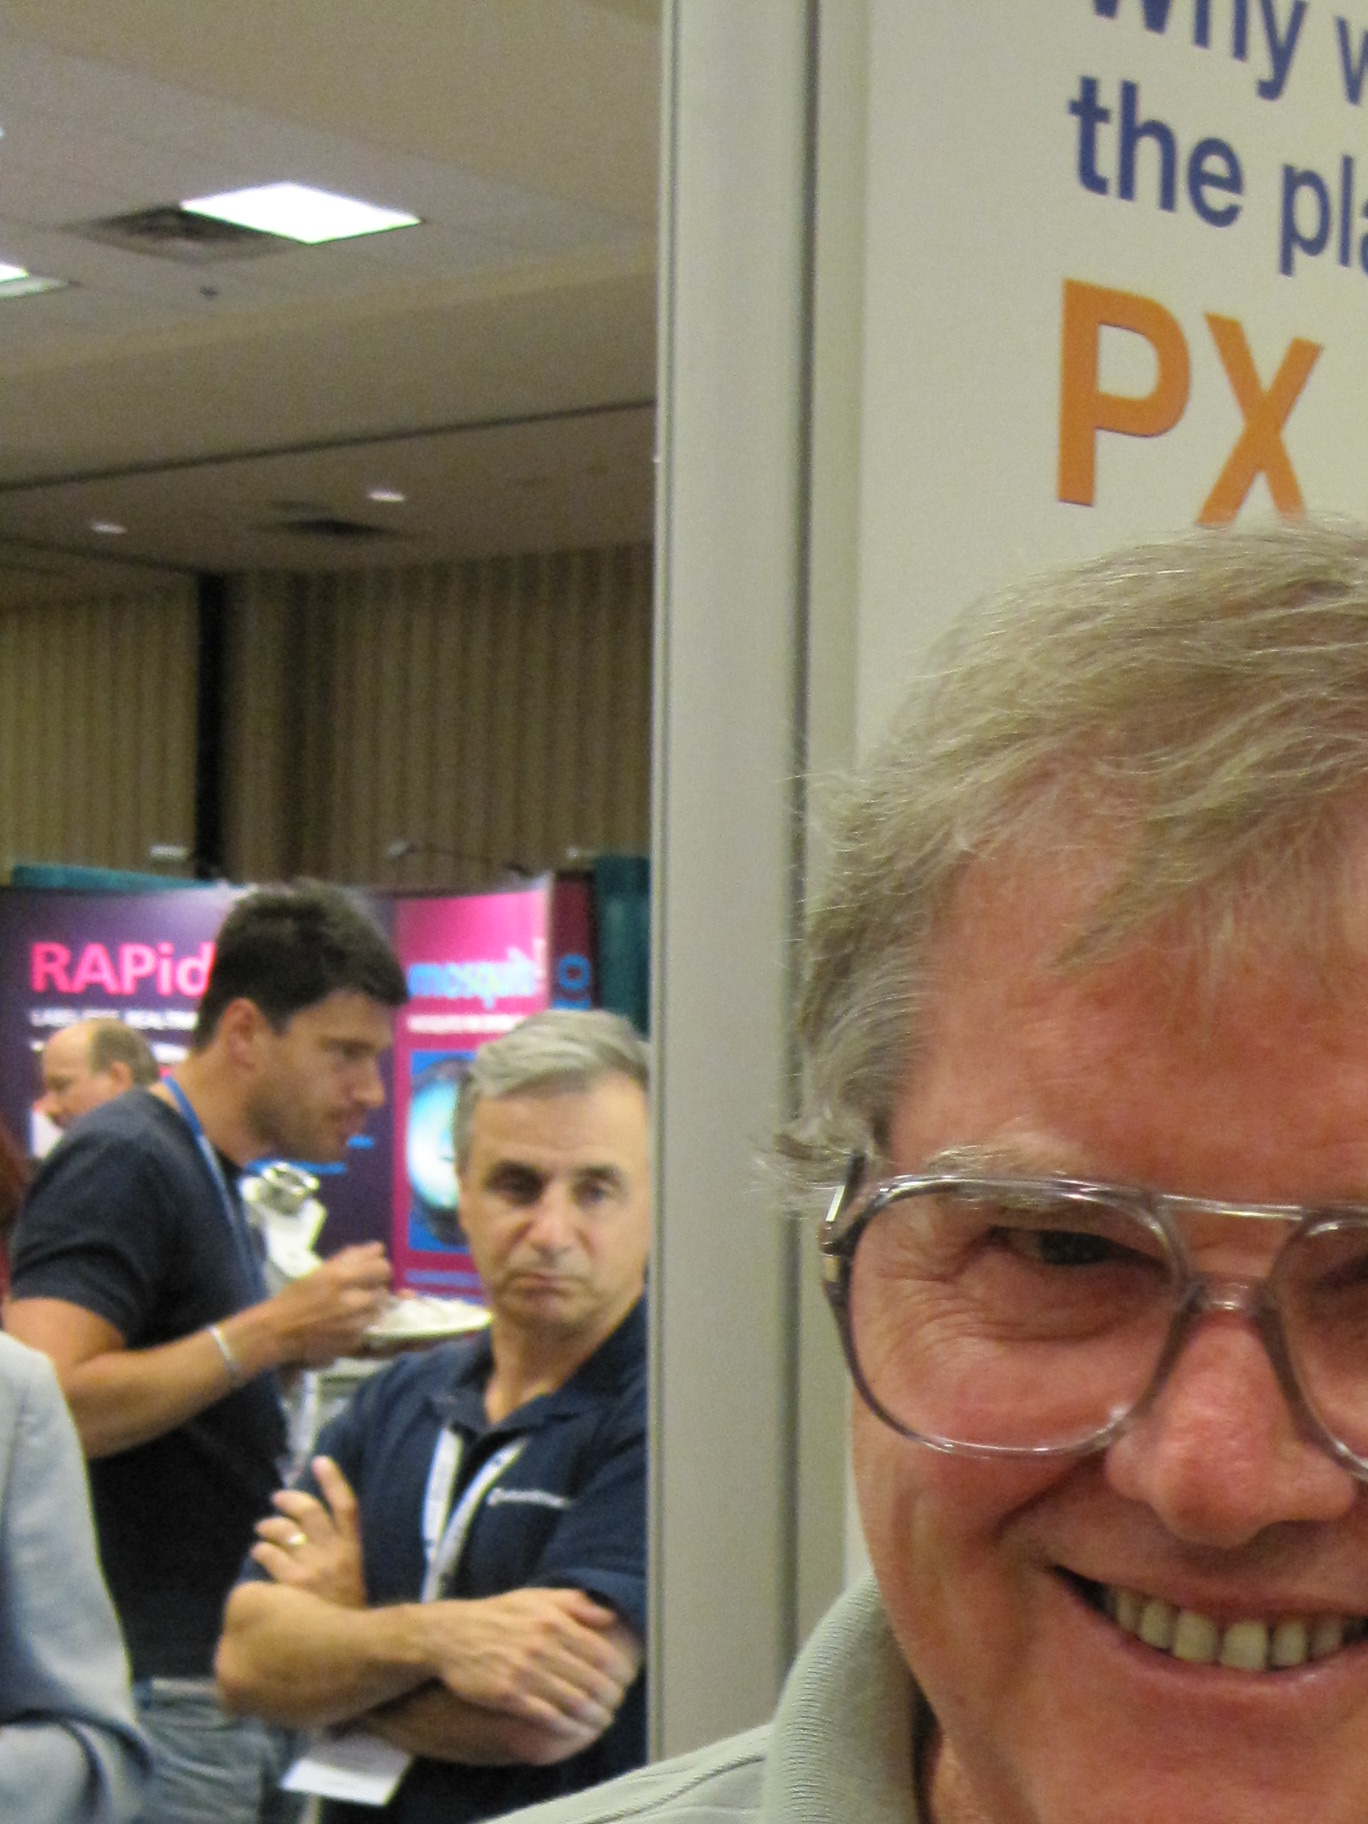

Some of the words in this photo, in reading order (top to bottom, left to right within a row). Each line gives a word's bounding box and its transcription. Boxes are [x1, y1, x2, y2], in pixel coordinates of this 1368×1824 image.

[1068, 75, 1244, 228] the
[1056, 277, 1324, 528] PX
[31, 941, 216, 996] RAPid
